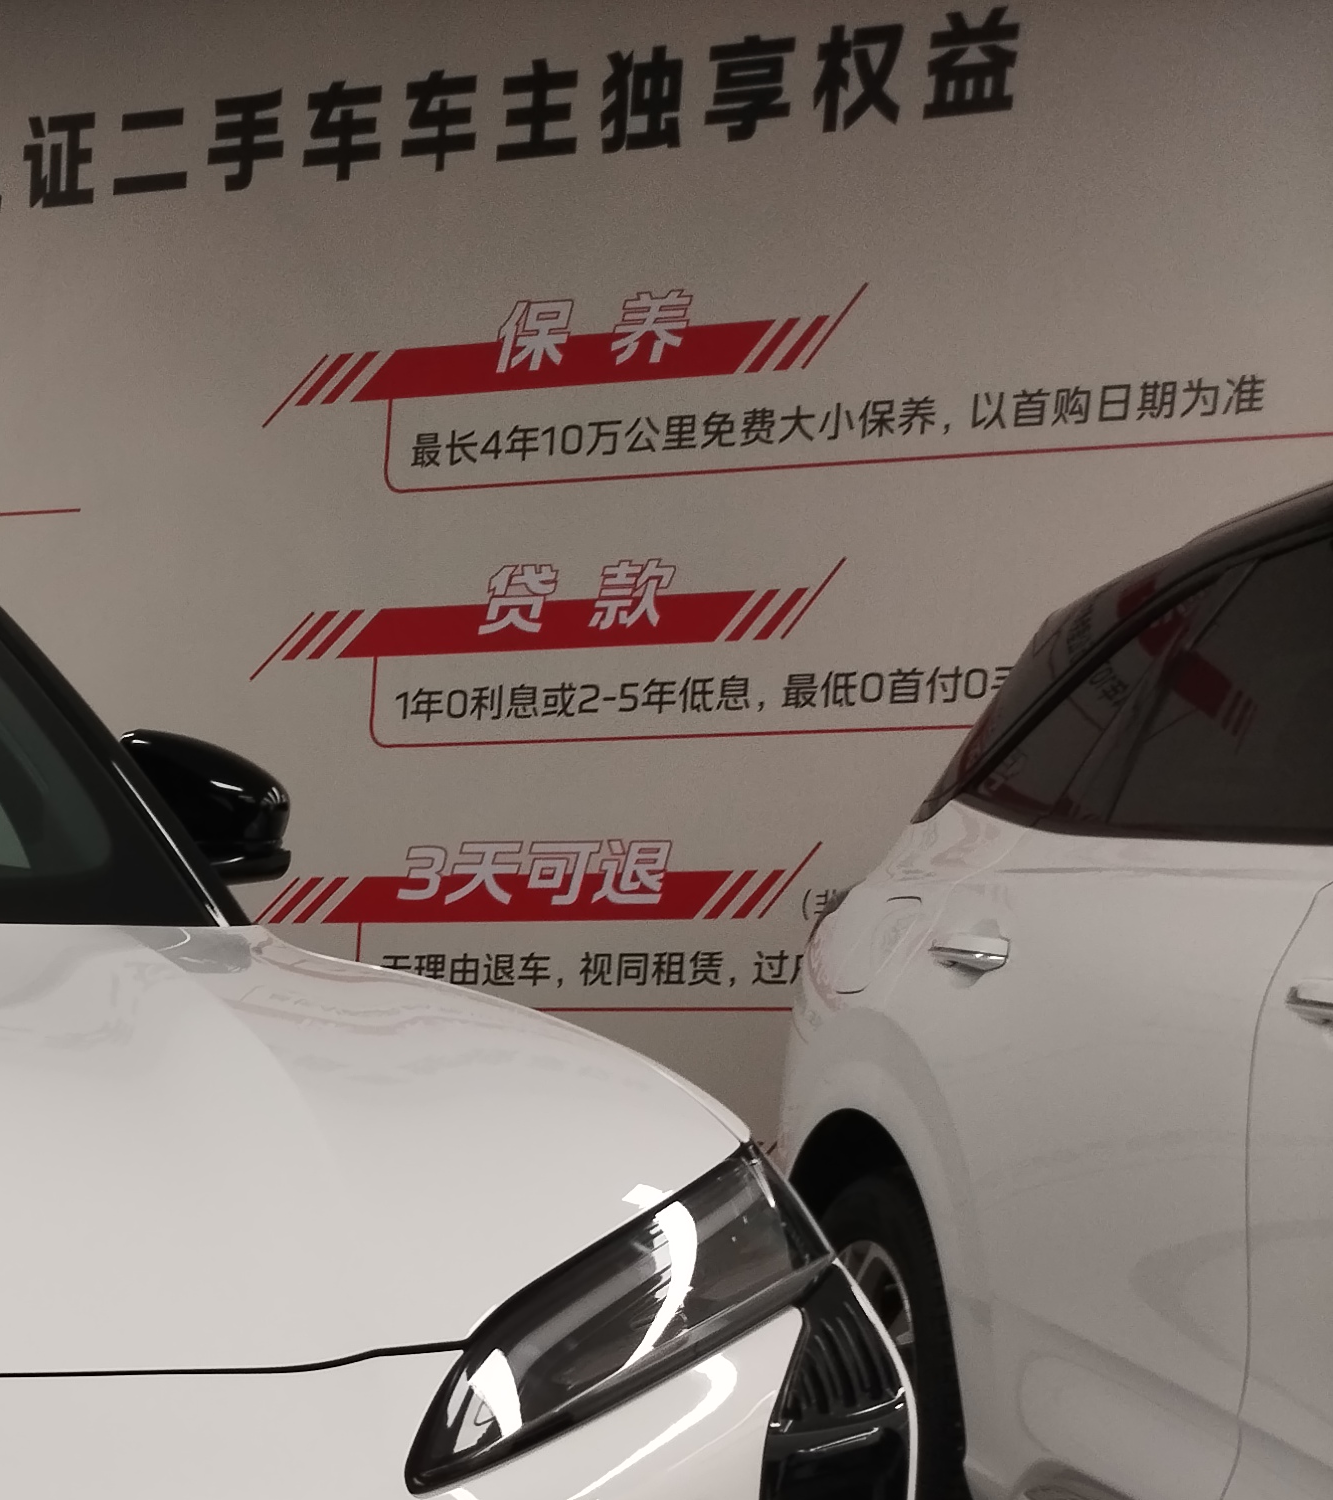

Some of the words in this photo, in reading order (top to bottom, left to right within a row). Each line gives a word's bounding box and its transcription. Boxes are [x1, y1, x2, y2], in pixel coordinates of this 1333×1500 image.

[495, 289, 694, 374] 保养
[476, 558, 678, 636] 贷款
[395, 840, 673, 907] 3天可退
